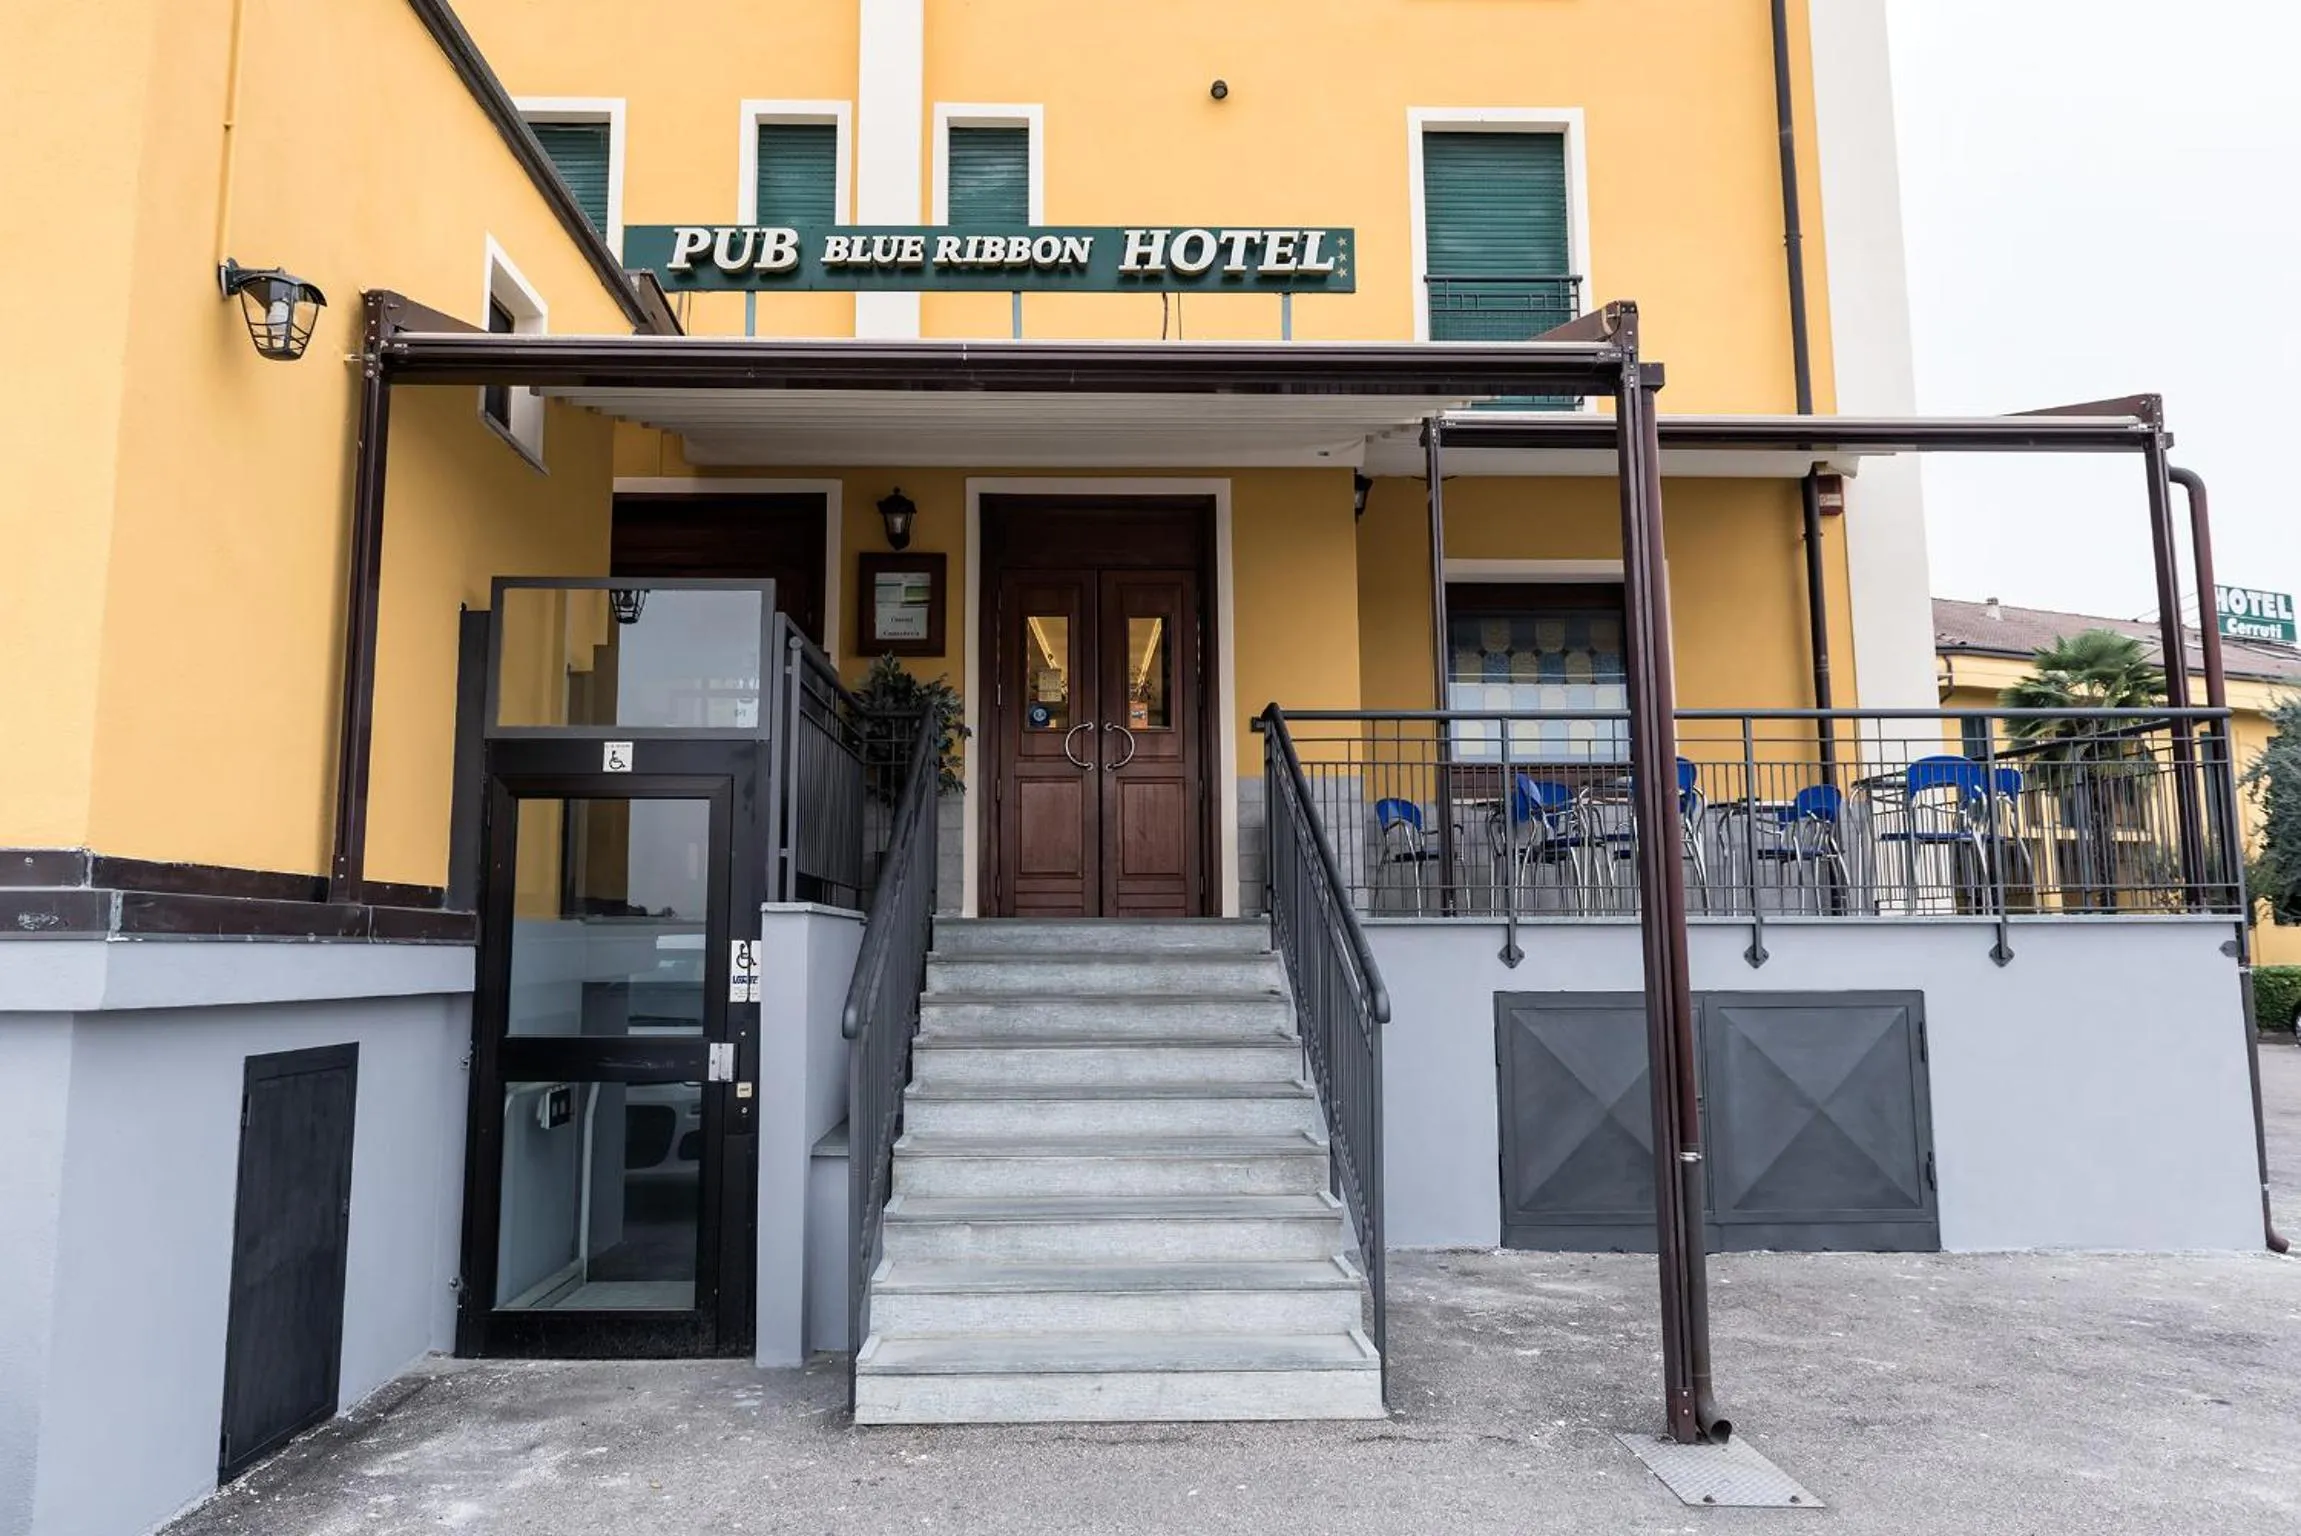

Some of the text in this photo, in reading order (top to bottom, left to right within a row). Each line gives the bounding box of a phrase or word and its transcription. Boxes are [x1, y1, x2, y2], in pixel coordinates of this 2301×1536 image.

[667, 228, 1335, 275] PUB BLUE RIBBON HOTEL
[2215, 586, 2293, 620] HOTEL
[2227, 617, 2282, 639] Cerruti
